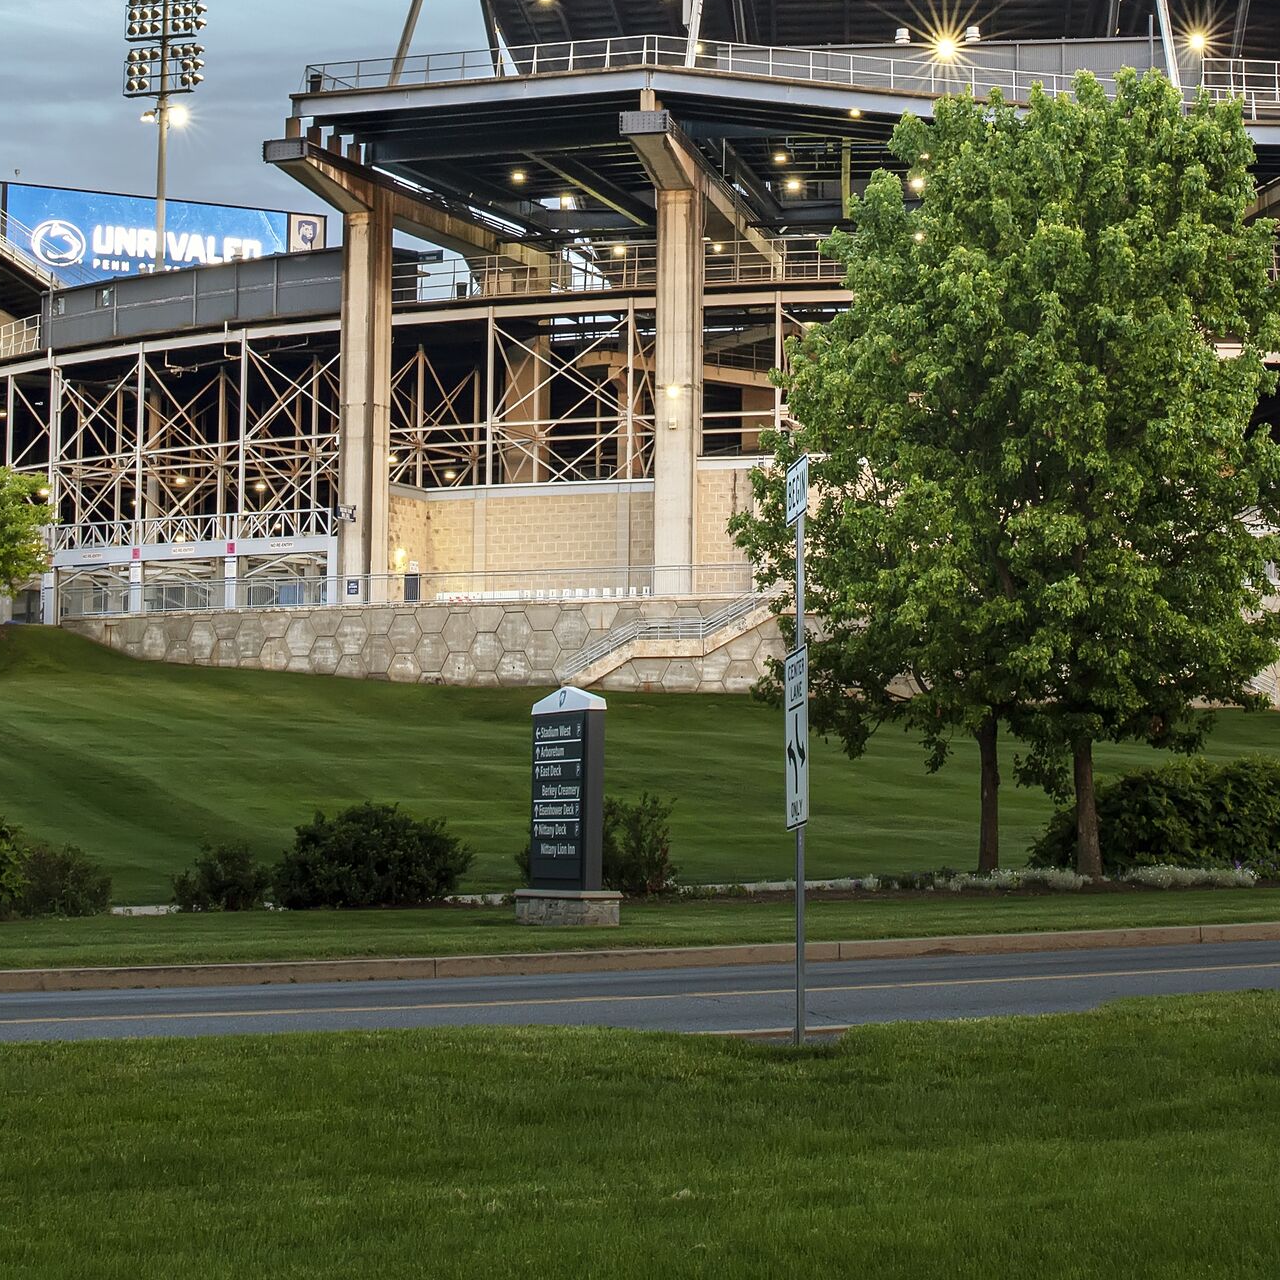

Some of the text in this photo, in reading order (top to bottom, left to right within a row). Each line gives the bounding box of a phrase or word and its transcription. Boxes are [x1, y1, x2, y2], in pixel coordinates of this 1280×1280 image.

[93, 258, 130, 271] PENN
[788, 468, 806, 512] BEGIN
[788, 657, 804, 681] CENTER
[790, 681, 802, 702] LANE
[540, 725, 558, 738] Stadium
[559, 724, 571, 736] West
[540, 746, 564, 757] Arboretum
[540, 766, 550, 777] East
[550, 765, 562, 776] Deck
[542, 784, 580, 798] Berkey Creamery
[539, 804, 563, 815] Eisenhower
[563, 803, 574, 815] Deck
[790, 798, 803, 818] ONLY
[538, 823, 555, 838] Nittany
[555, 823, 567, 835] Deck
[540, 843, 576, 858] Nittany Lion Inn
